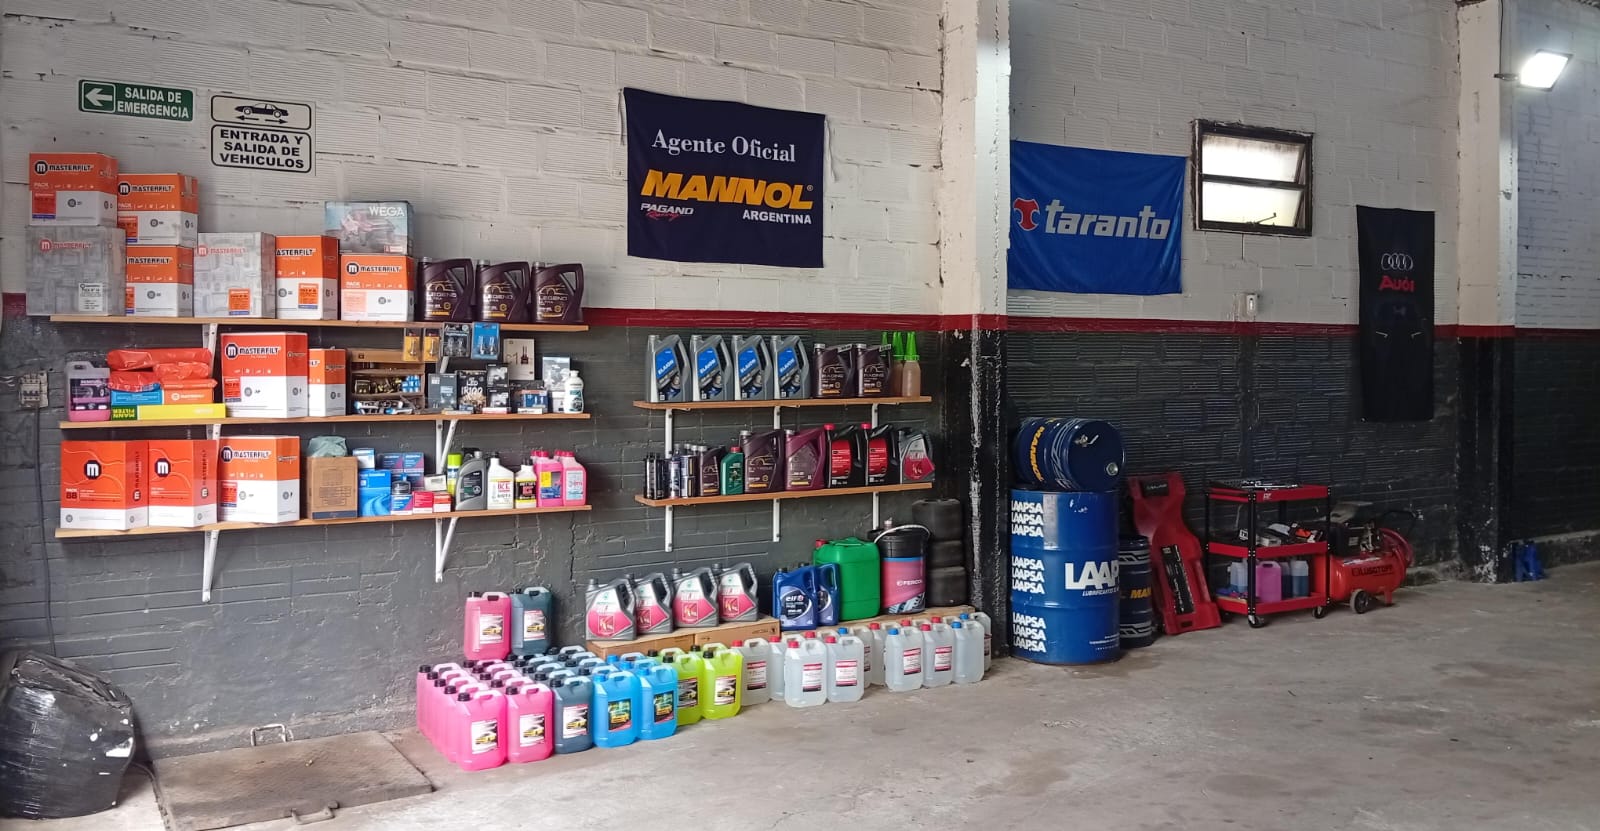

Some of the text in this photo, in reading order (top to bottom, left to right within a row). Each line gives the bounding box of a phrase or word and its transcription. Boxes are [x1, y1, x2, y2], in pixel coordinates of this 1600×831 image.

[124, 87, 182, 103] SALIDA DE
[117, 101, 189, 118] EMERGENCIA
[220, 129, 304, 145] ENTRADA Y
[224, 141, 300, 157] SALIDA DE
[651, 129, 796, 162] Agente Oficial
[219, 153, 304, 169] VEHICULOS
[641, 169, 813, 210] MANNOL
[369, 206, 405, 217] WEGA
[640, 203, 694, 215] PAGANO
[742, 209, 812, 225] ARGENTINA
[1045, 199, 1171, 240] taranto
[1379, 275, 1416, 292] Audi
[239, 346, 280, 355] MASTERFILT
[233, 450, 270, 458] MASTERFILT
